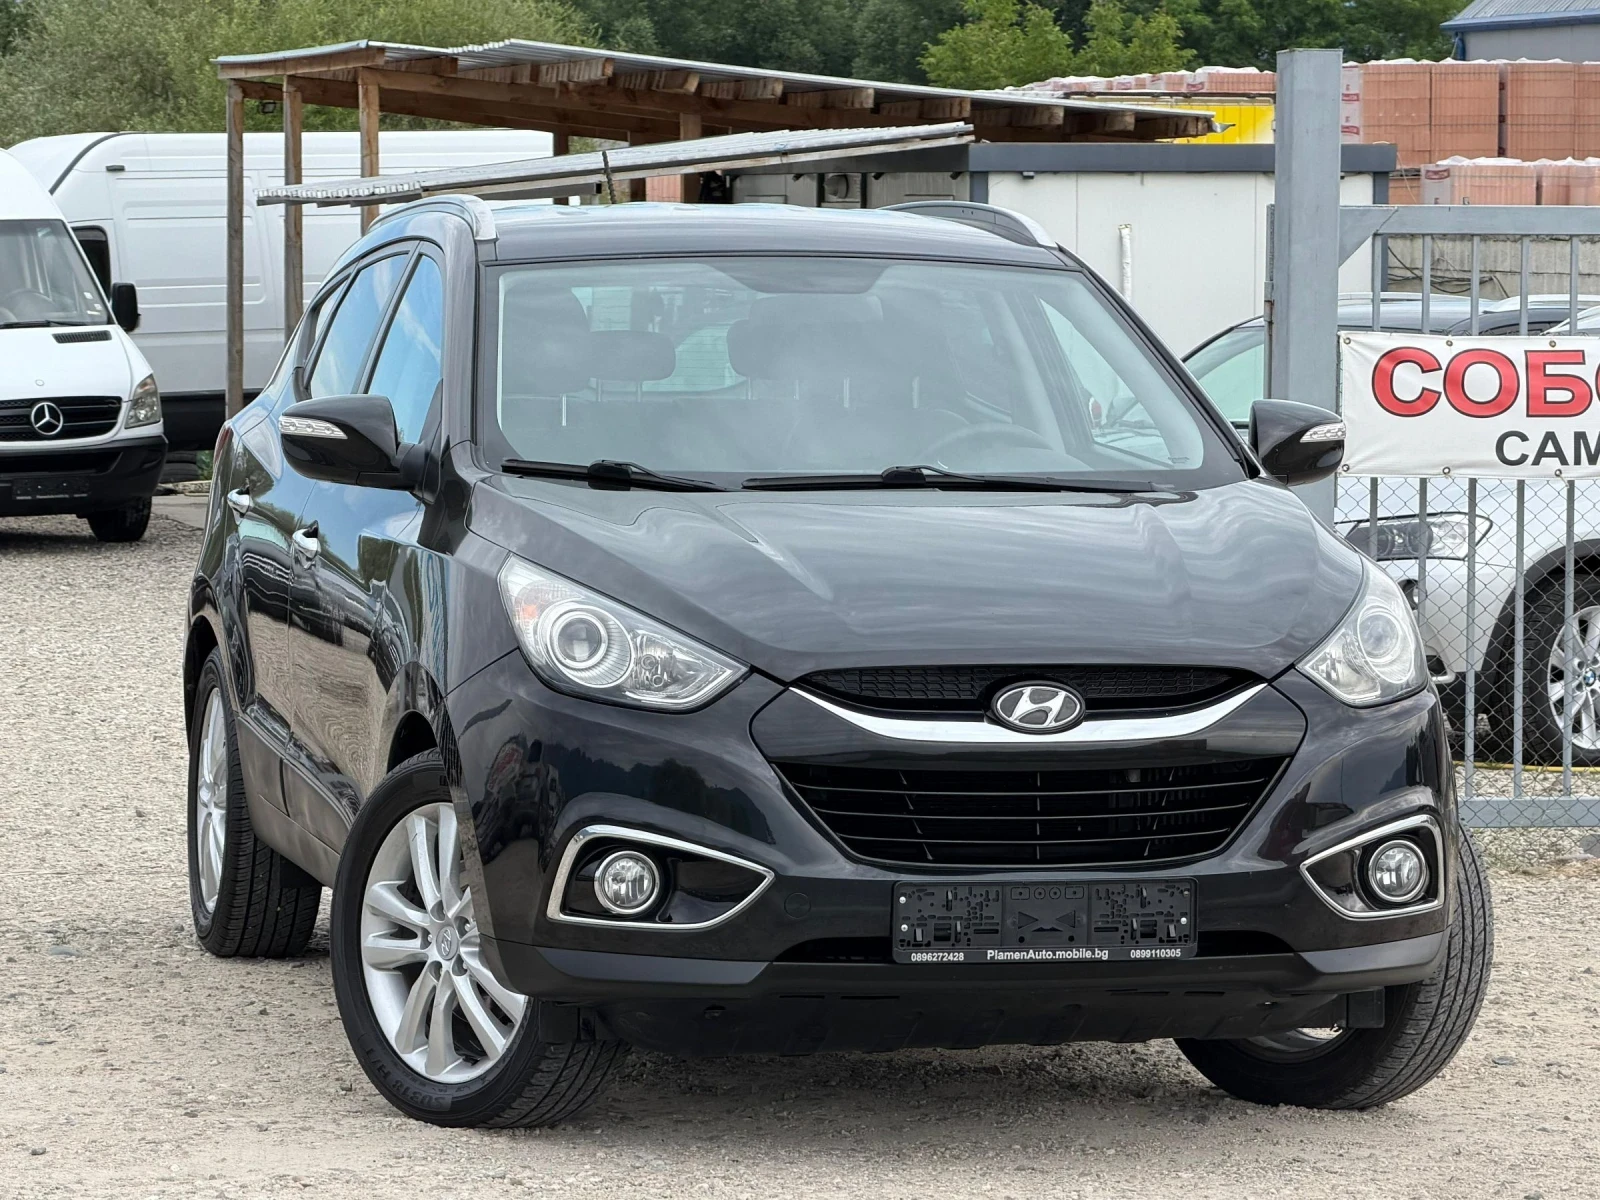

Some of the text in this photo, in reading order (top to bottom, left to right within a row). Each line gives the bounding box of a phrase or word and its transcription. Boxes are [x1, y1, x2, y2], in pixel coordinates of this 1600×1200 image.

[1372, 346, 1600, 418] СОБ
[911, 948, 1182, 962] 0896272428 PlamenAuto.mobile.bg 0899110305
